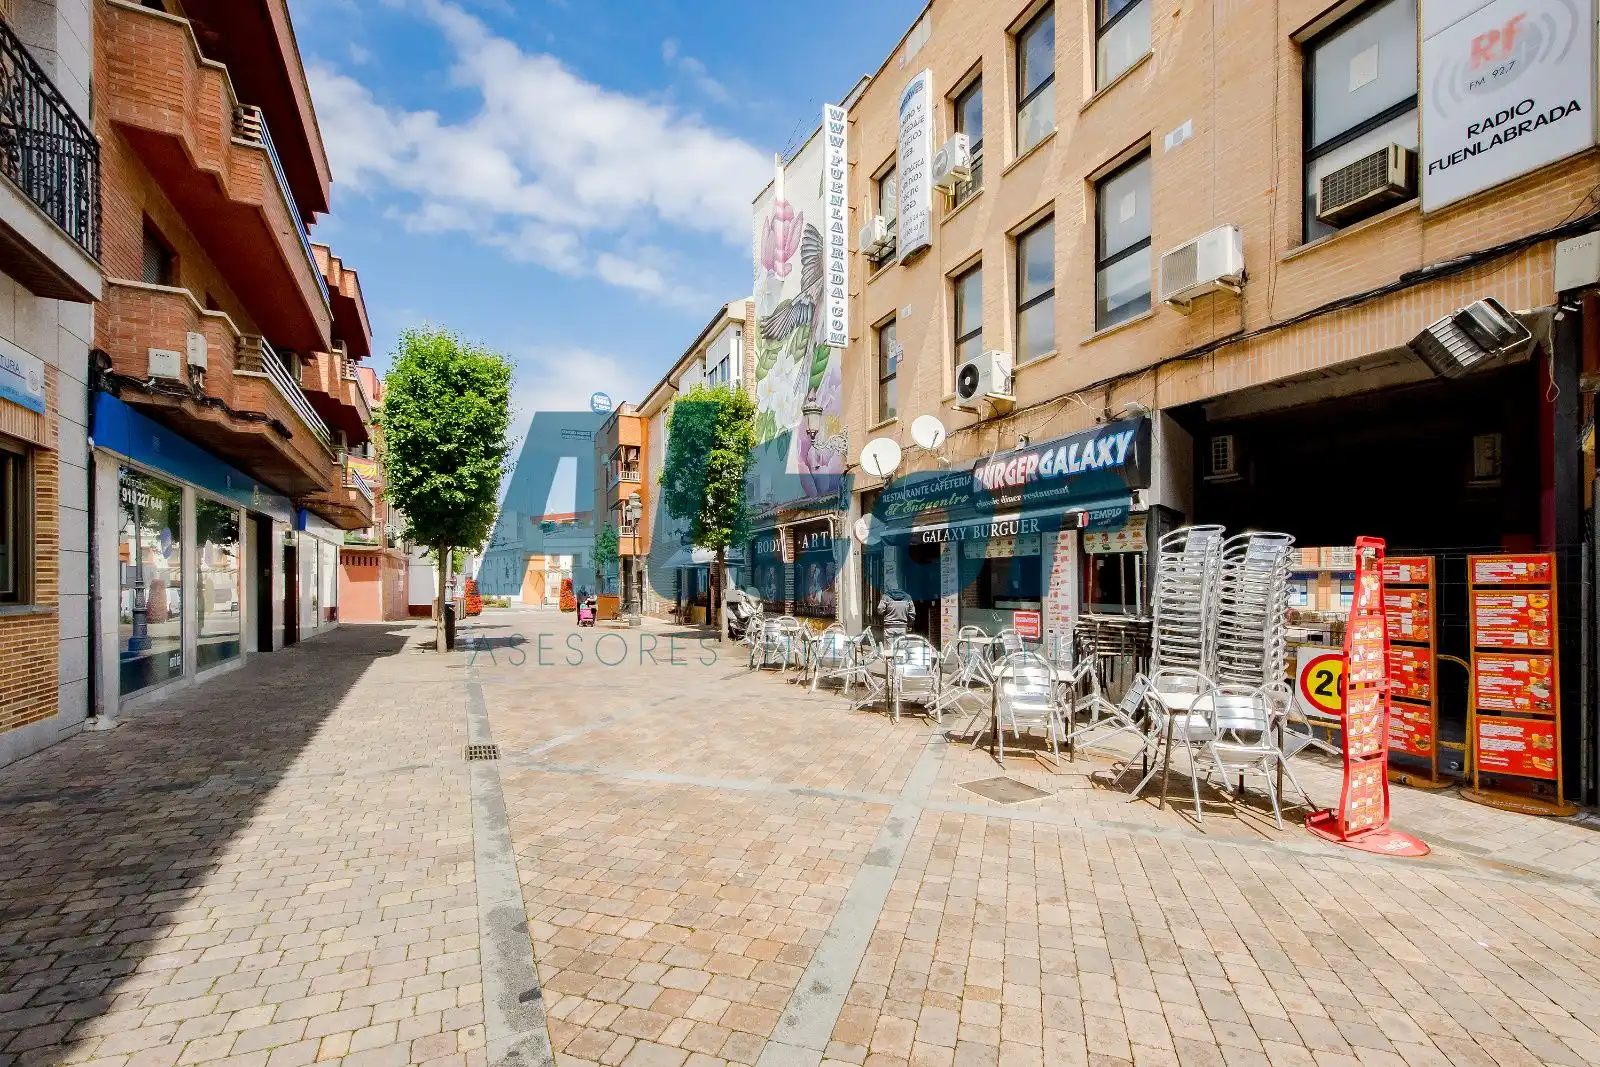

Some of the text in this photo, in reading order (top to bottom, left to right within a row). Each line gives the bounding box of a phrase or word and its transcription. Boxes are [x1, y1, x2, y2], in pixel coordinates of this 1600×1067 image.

[1468, 77, 1486, 91] FM
[1467, 98, 1535, 139] RADIO
[1428, 99, 1582, 176] FUENLABRADA
[882, 485, 930, 504] RESTAURANTE
[903, 492, 970, 514] Encuentro
[976, 486, 1070, 509] classic diner restaurant
[1089, 507, 1122, 520] TEMPLO
[922, 517, 1041, 543] GALAXY BURGUER
